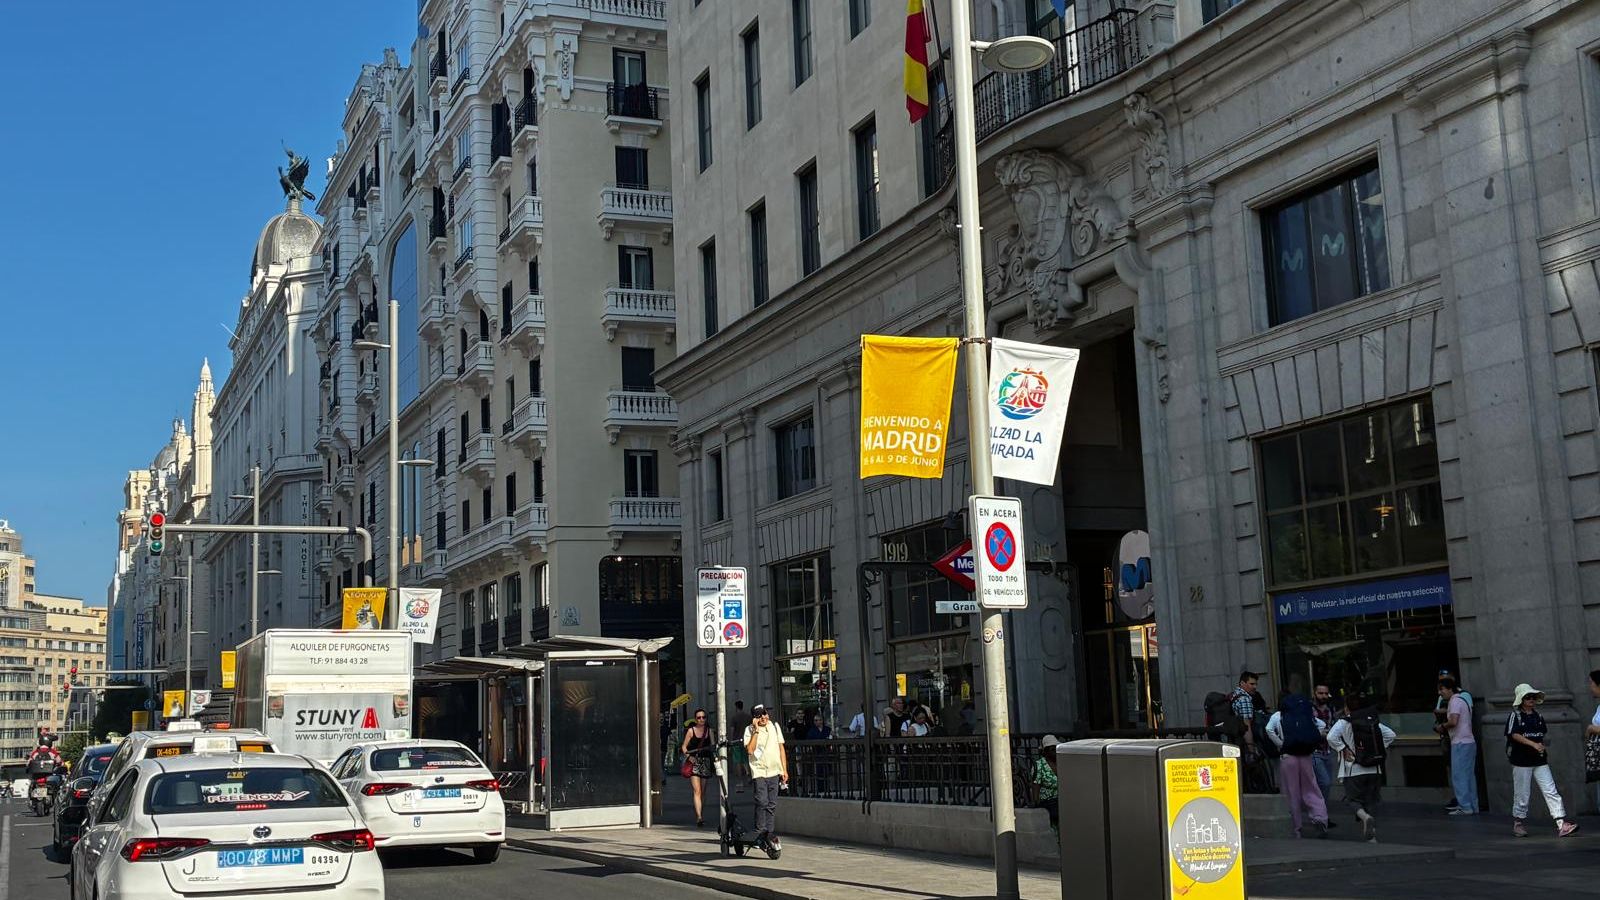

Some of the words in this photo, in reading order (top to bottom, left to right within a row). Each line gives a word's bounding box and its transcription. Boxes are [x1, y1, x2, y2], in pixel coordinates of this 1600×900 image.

[933, 419, 943, 431] A
[863, 430, 942, 456] MADRID
[1025, 430, 1043, 445] LA
[887, 454, 894, 463] 9
[895, 454, 908, 464] DE
[910, 456, 939, 467] JUNIO
[979, 507, 990, 517] EN
[993, 508, 1018, 519] ACERA
[883, 542, 909, 562] 1919
[957, 557, 975, 570] Me
[988, 575, 1003, 583] TODO
[1005, 575, 1018, 583] TIPO
[984, 588, 992, 596] DE
[1311, 600, 1339, 610] Movistar,
[1345, 597, 1357, 606] red
[1357, 594, 1377, 604] oficial
[1376, 592, 1386, 602] de
[1386, 590, 1412, 600] nuestra
[952, 602, 976, 612] Gran
[290, 643, 327, 652] ALQUILER
[328, 643, 339, 651] DE
[340, 643, 390, 652] FURGONETAS
[309, 657, 324, 665] TLF:
[325, 657, 333, 665] 91
[334, 657, 348, 665] 884
[349, 657, 358, 665] 43
[359, 657, 368, 665] 28
[295, 709, 361, 726] STUNY
[295, 731, 383, 742] www.stunyrent.com
[207, 792, 285, 804] FREENOW
[271, 848, 301, 863] MMP
[182, 858, 196, 875] J
